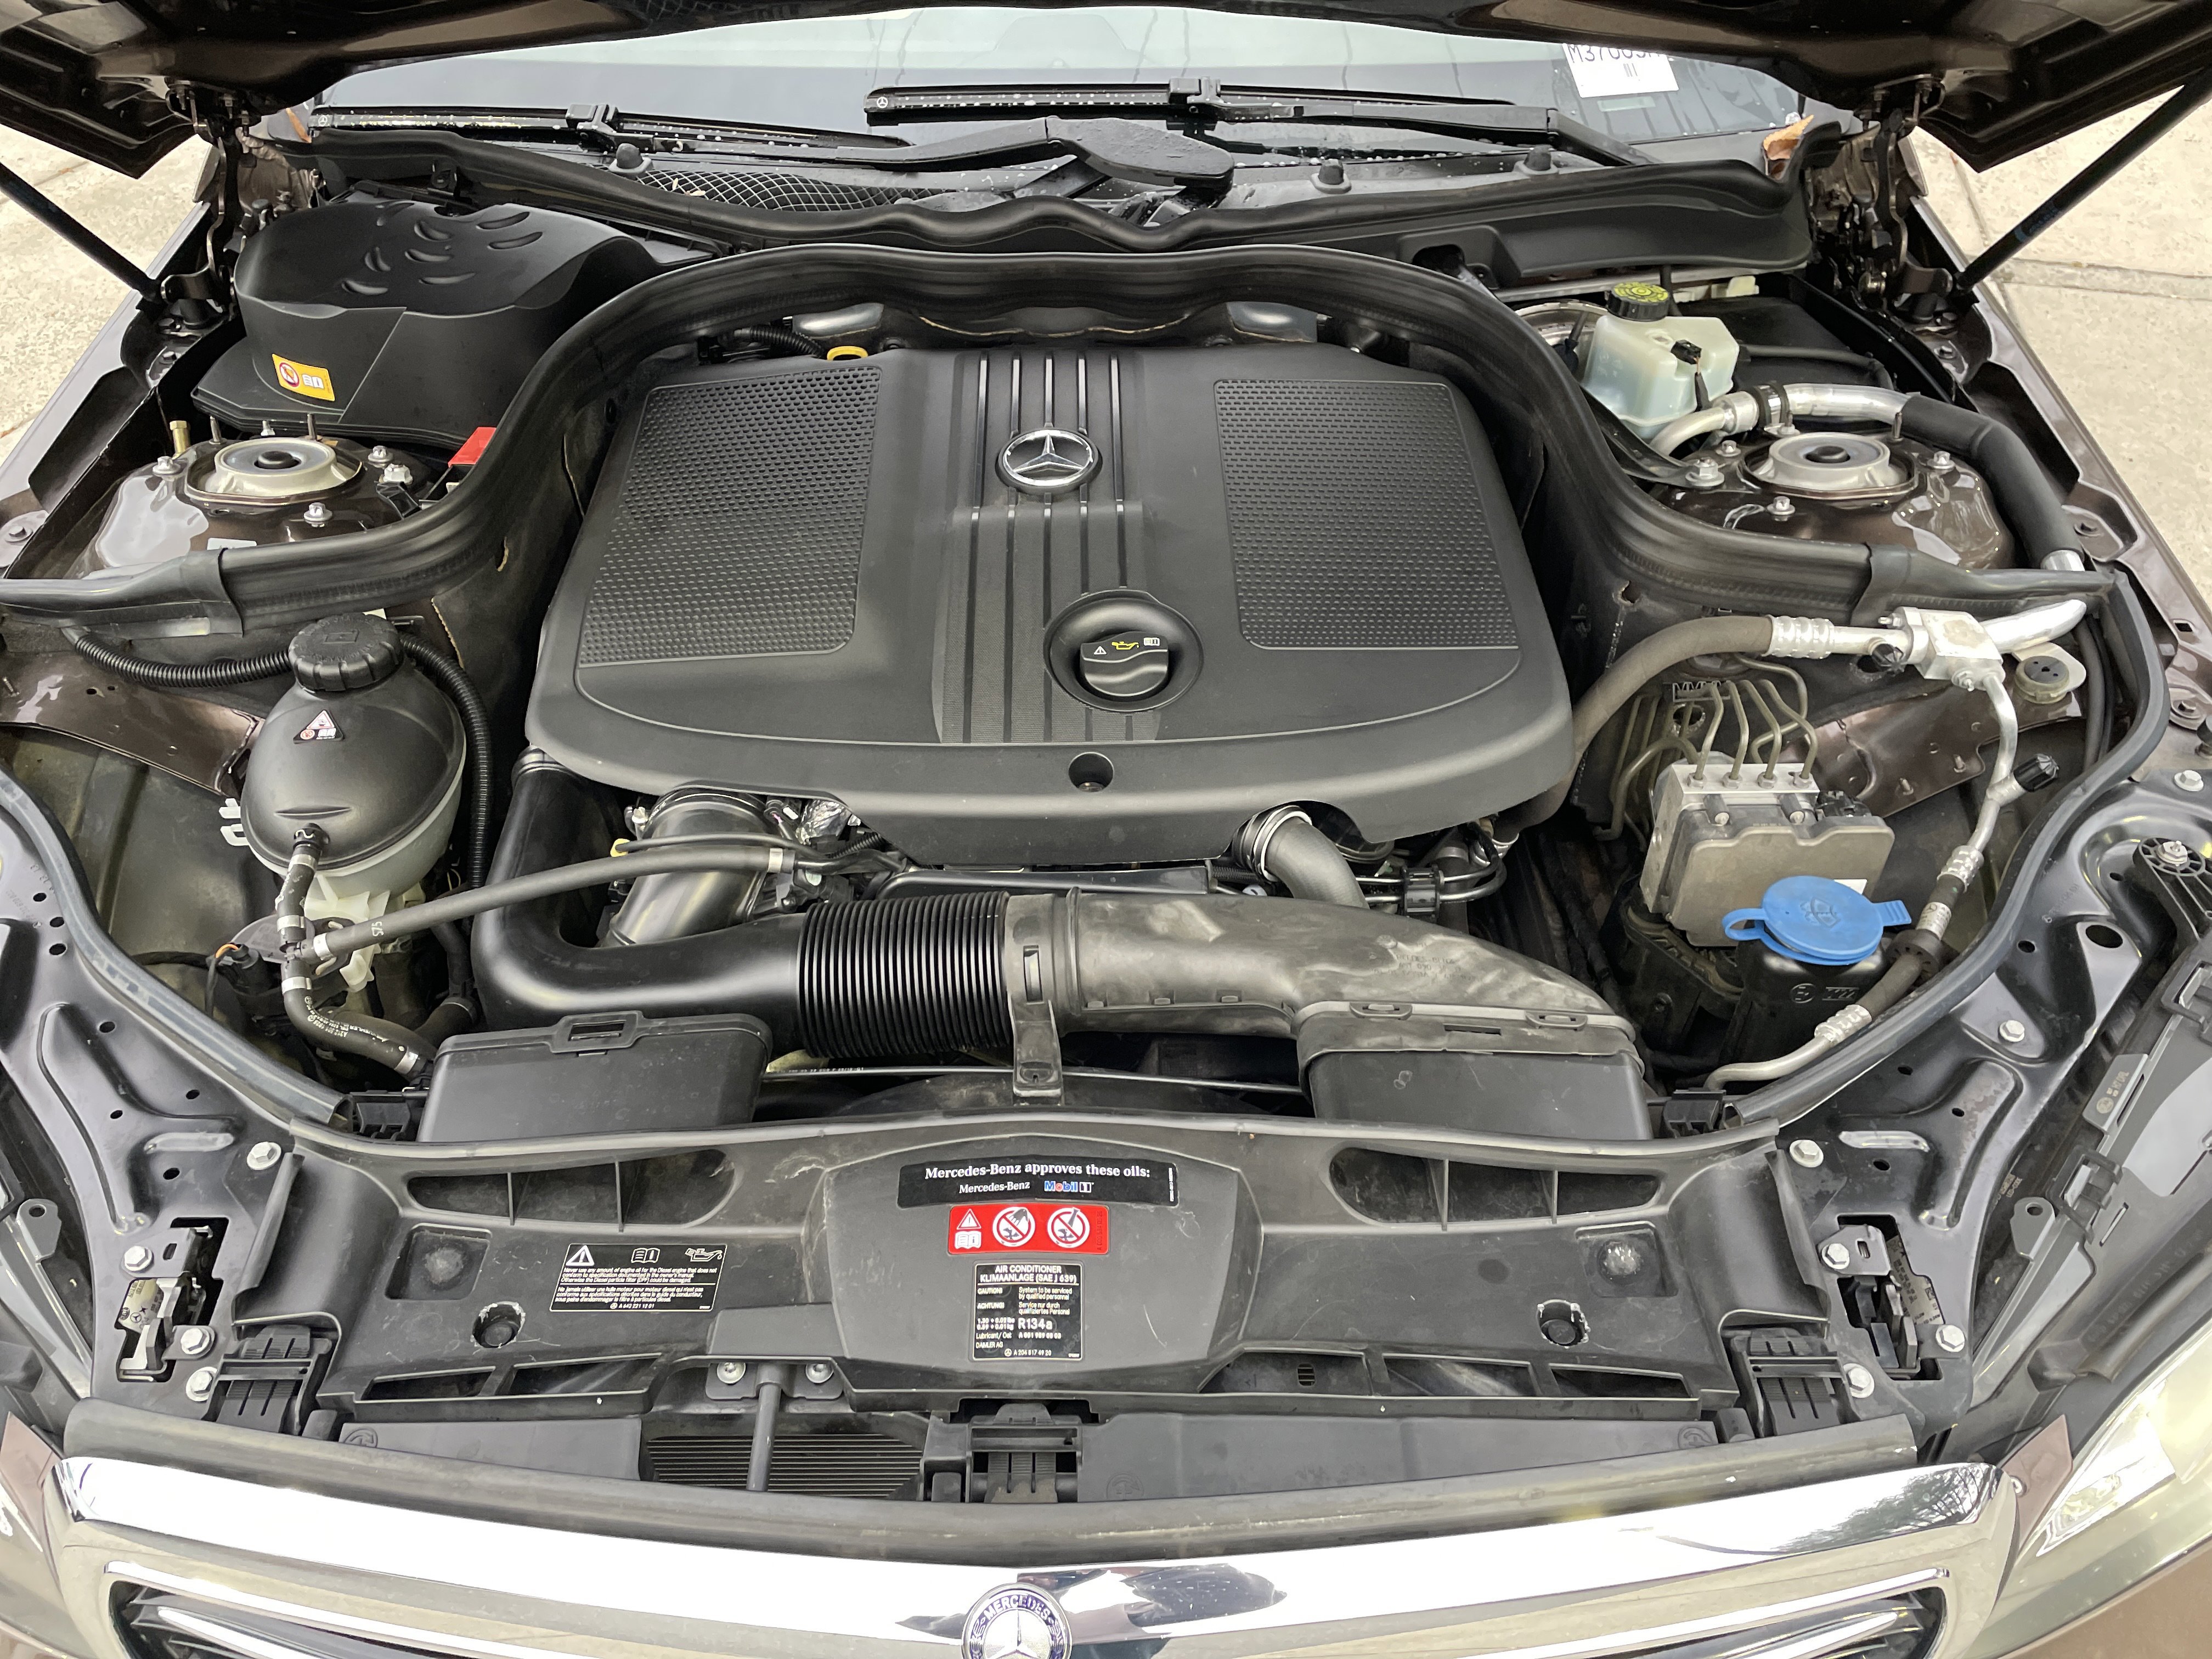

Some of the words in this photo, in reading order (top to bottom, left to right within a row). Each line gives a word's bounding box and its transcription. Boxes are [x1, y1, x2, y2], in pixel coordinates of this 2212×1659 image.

[925, 1164, 1022, 1180] Mercedes-Benz
[1024, 1163, 1082, 1175] approves
[1086, 1164, 1120, 1176] these
[1123, 1165, 1150, 1178] oils:
[959, 1181, 1030, 1194] Mercedes-Benz
[1044, 1180, 1079, 1193] Mobil
[995, 1265, 1008, 1273] AIR
[1009, 1265, 1062, 1273] CONDITIONER
[980, 1273, 1035, 1283] KLIMAANLAGE
[1035, 1274, 1053, 1283] (SAE
[1054, 1274, 1058, 1283] J
[1059, 1274, 1077, 1283] 639)
[1018, 1317, 1053, 1330] R134a
[984, 1594, 1050, 1621] MERCEDES
